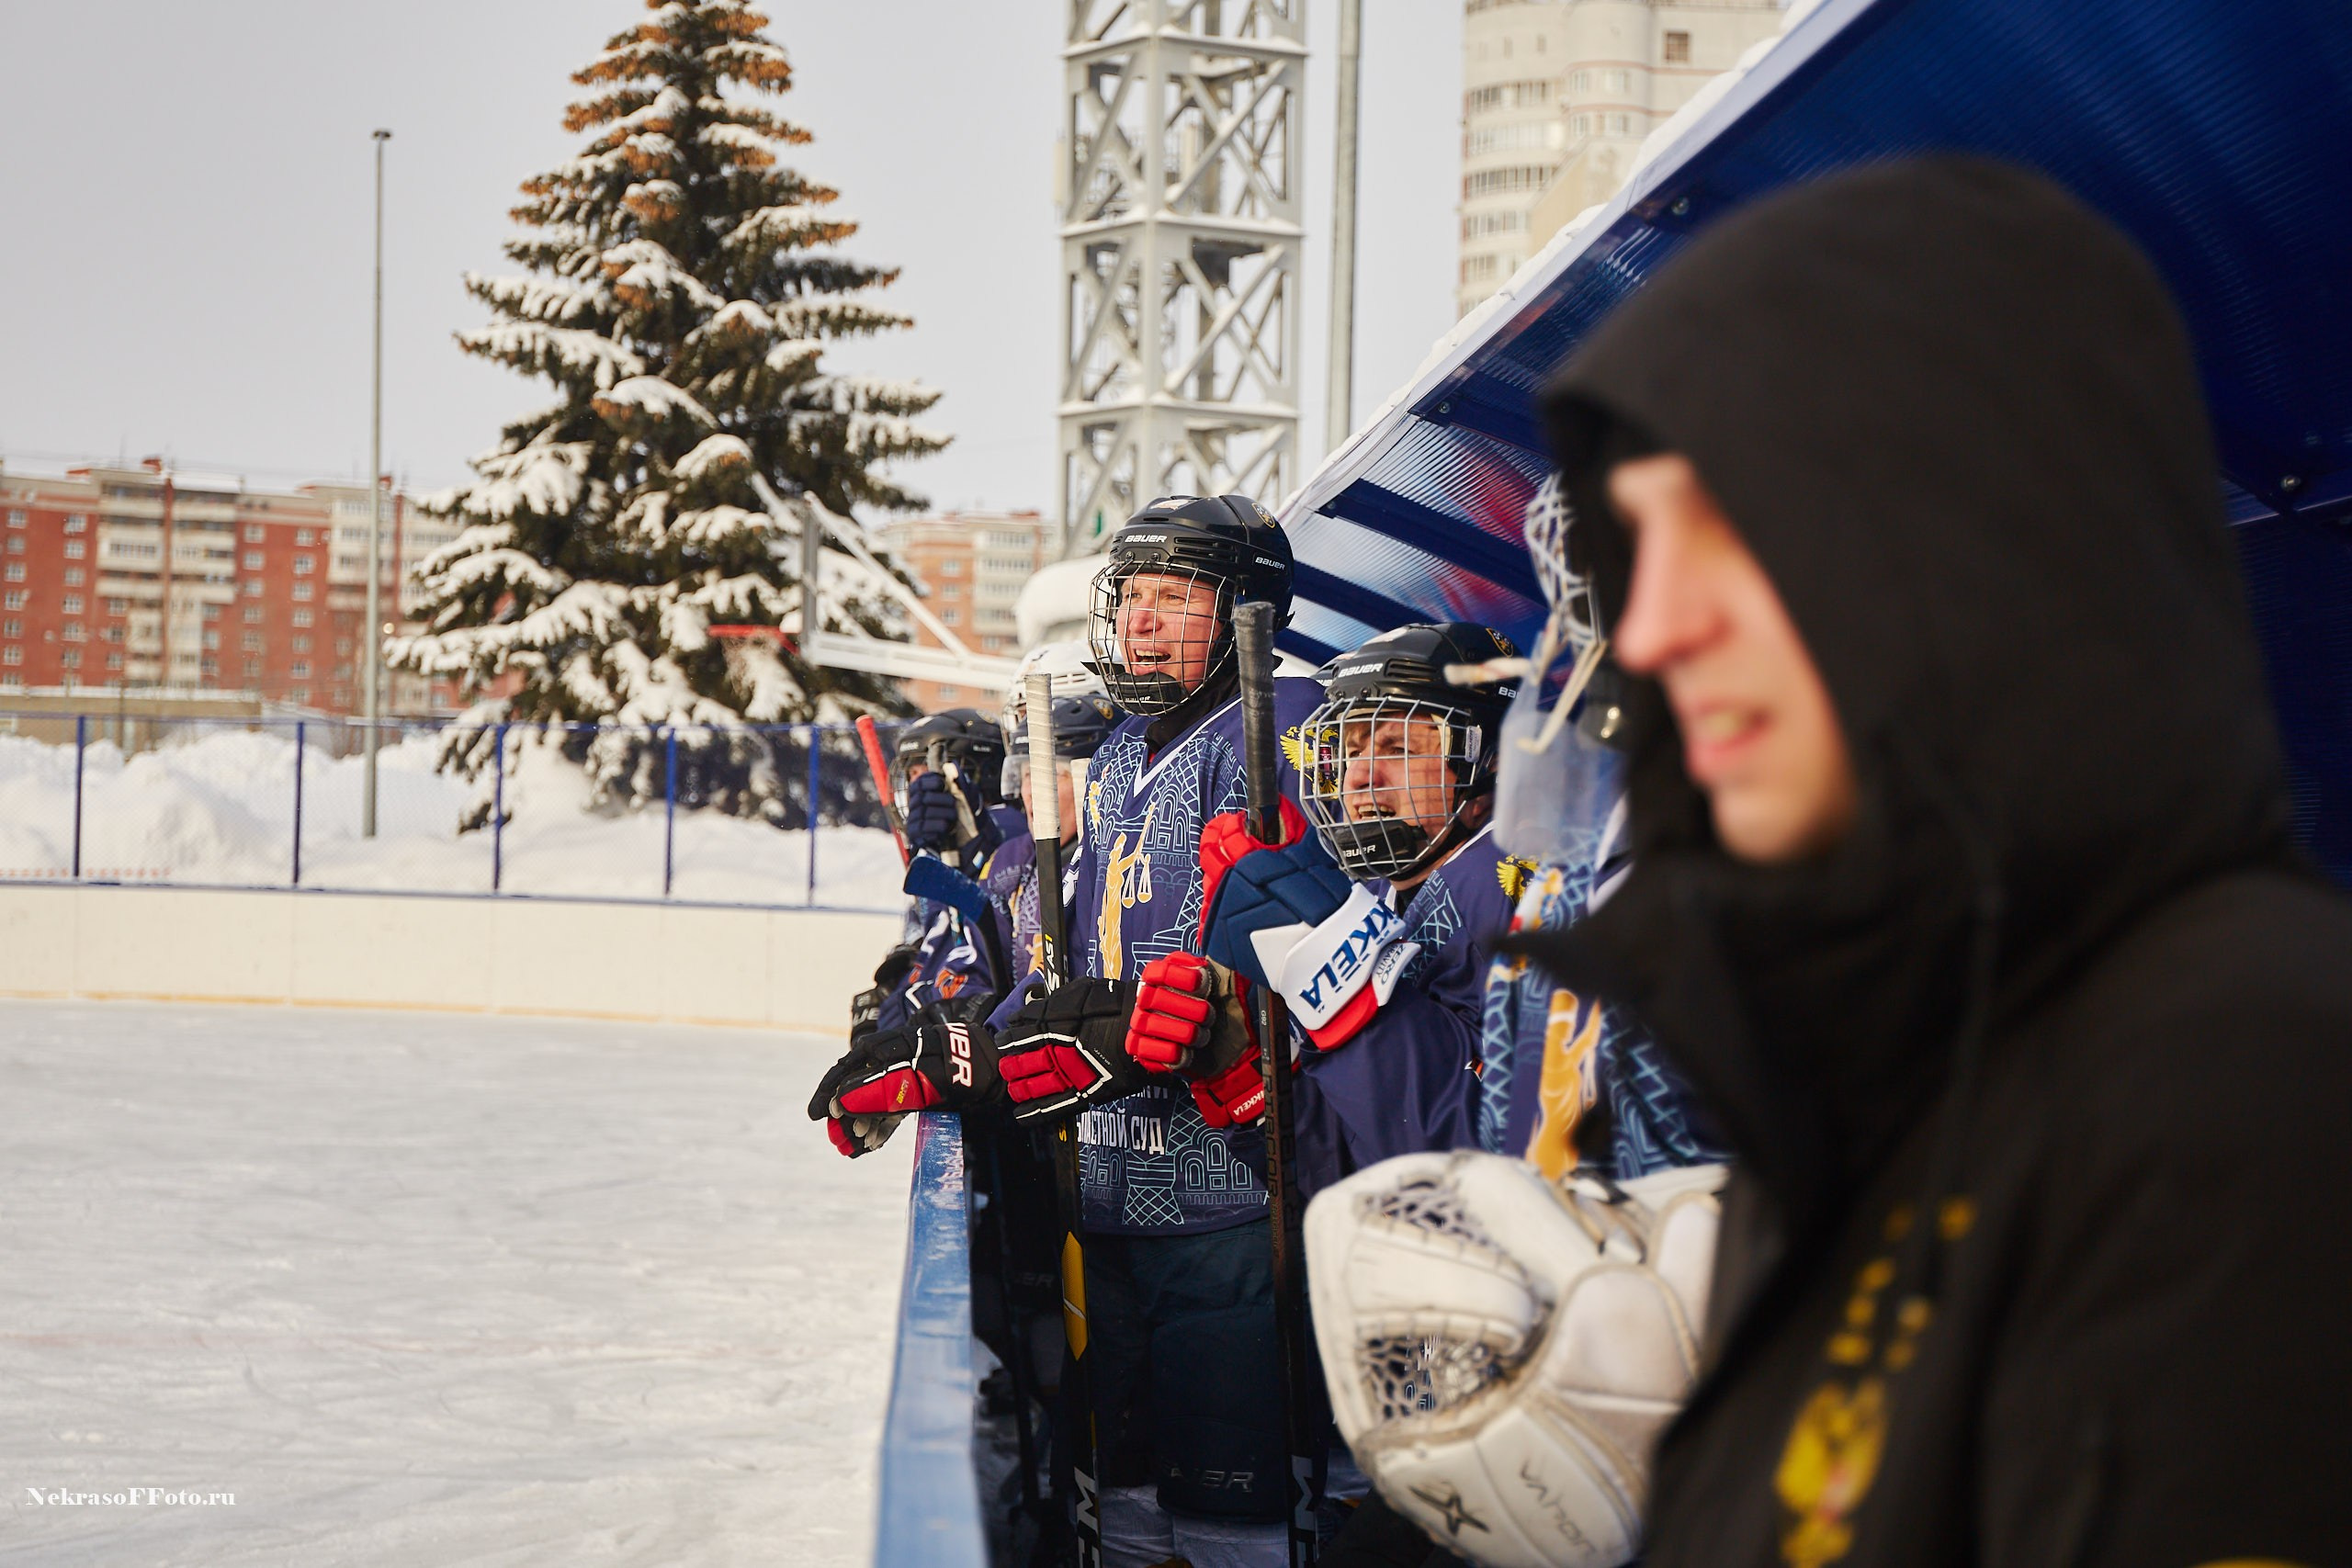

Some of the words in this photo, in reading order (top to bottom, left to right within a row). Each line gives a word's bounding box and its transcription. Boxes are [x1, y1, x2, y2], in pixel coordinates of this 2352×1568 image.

[1125, 534, 1168, 544] BAUER
[1255, 557, 1285, 570] BAUER
[1338, 662, 1384, 678] BAUER
[1342, 844, 1376, 858] AUER
[1130, 1115, 1165, 1155] СУД
